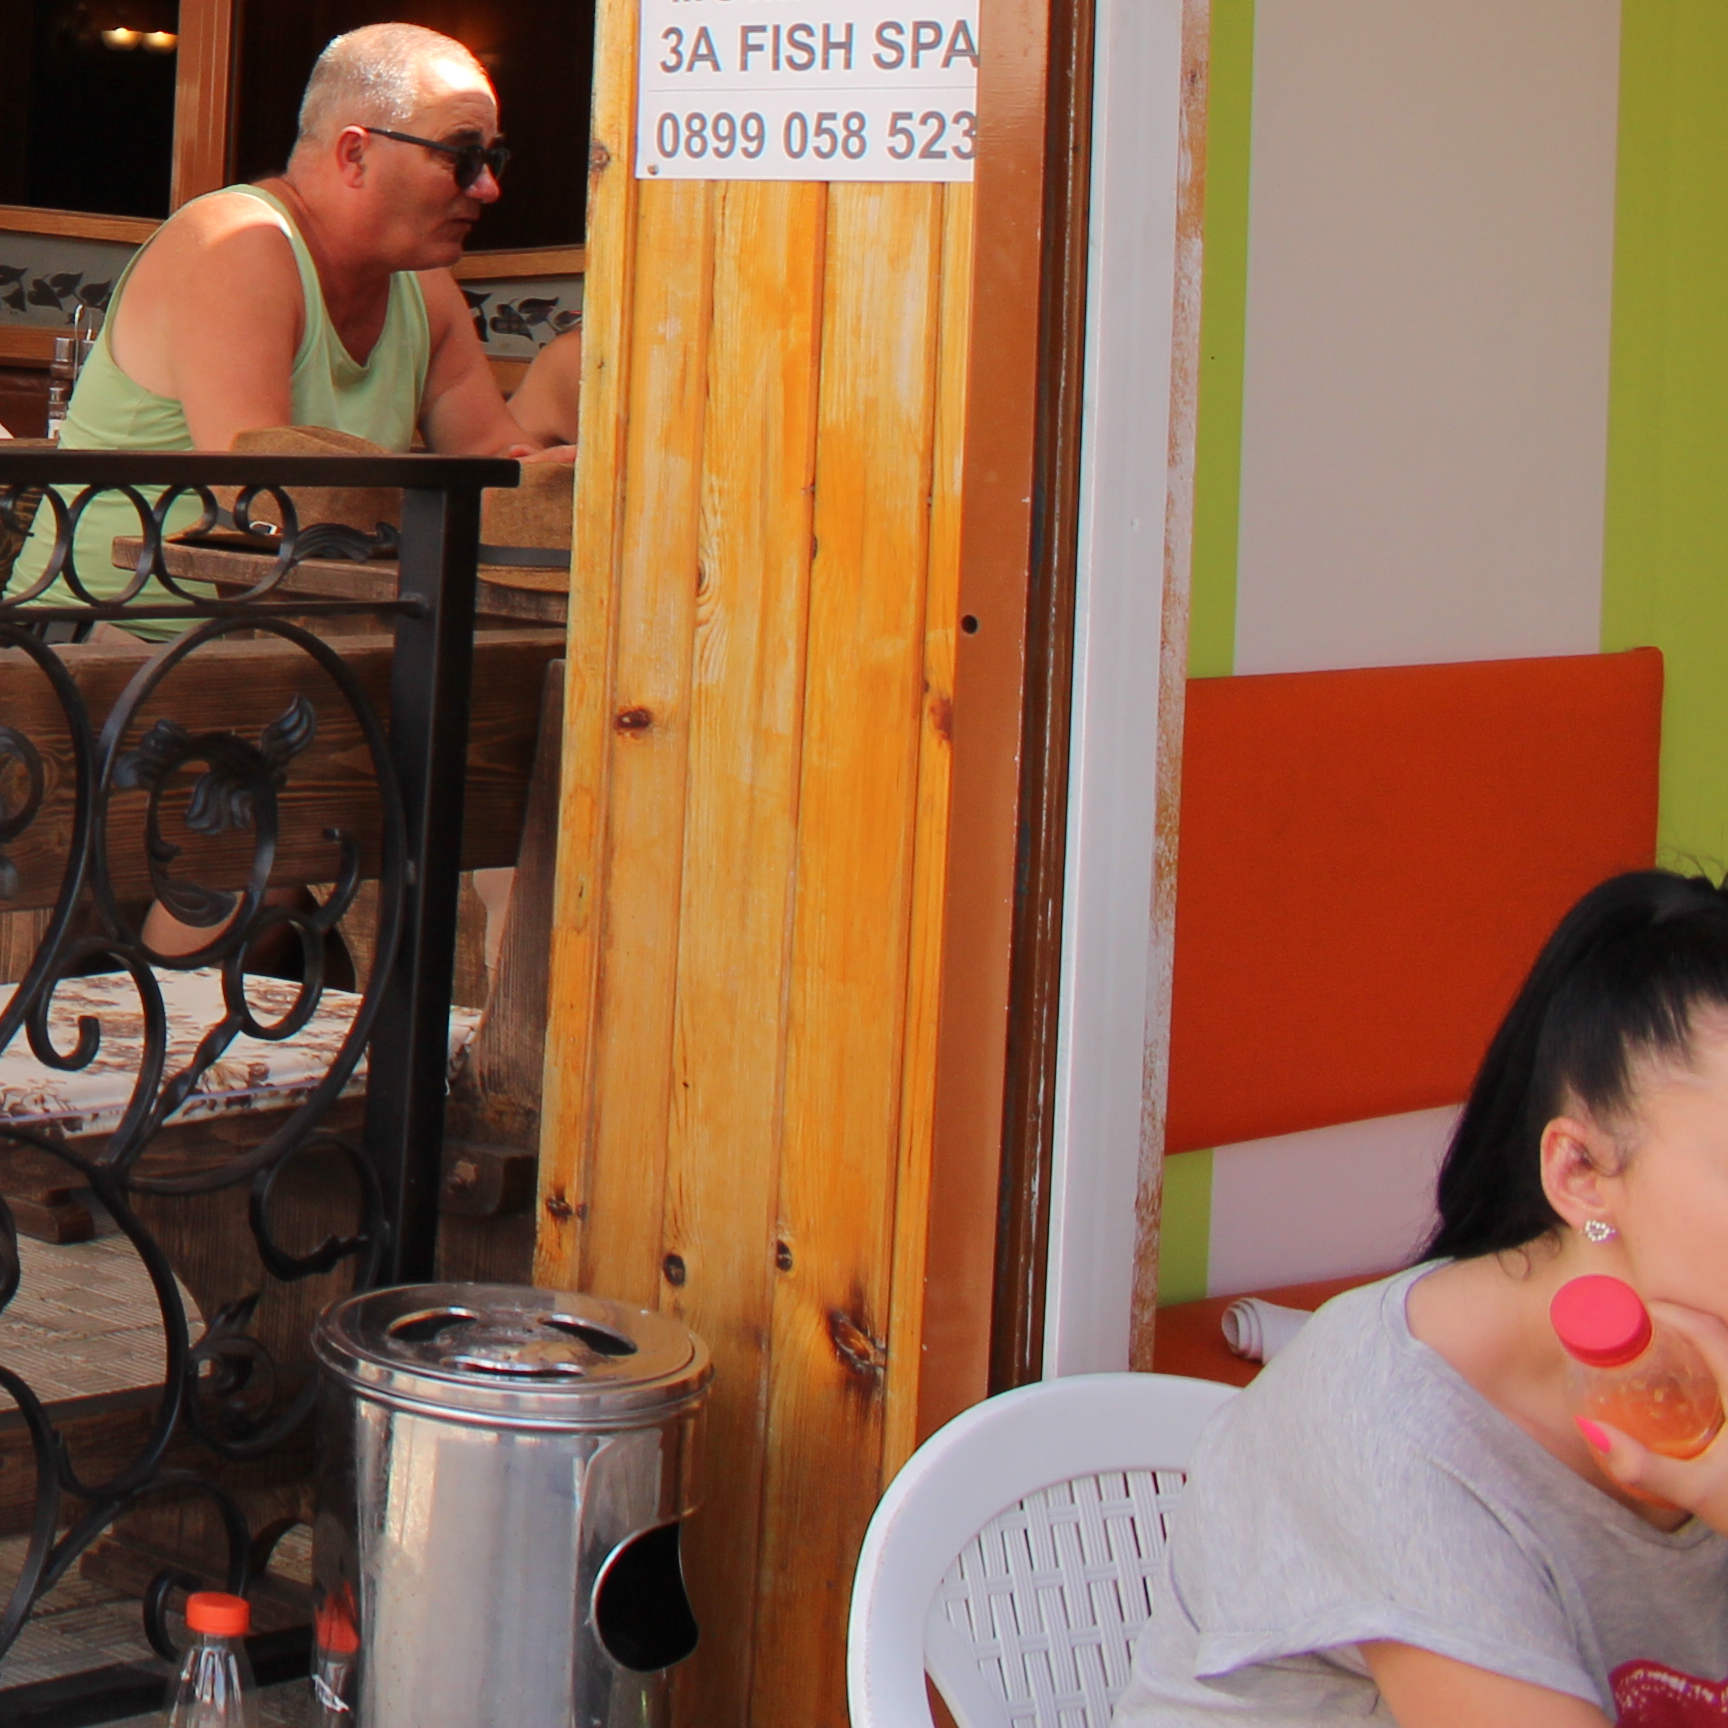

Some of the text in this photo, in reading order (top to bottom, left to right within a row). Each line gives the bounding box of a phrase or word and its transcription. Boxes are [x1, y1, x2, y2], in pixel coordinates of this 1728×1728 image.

[660, 19, 980, 73] ЗА FISH SPA
[655, 110, 978, 161] 0899 058 523
